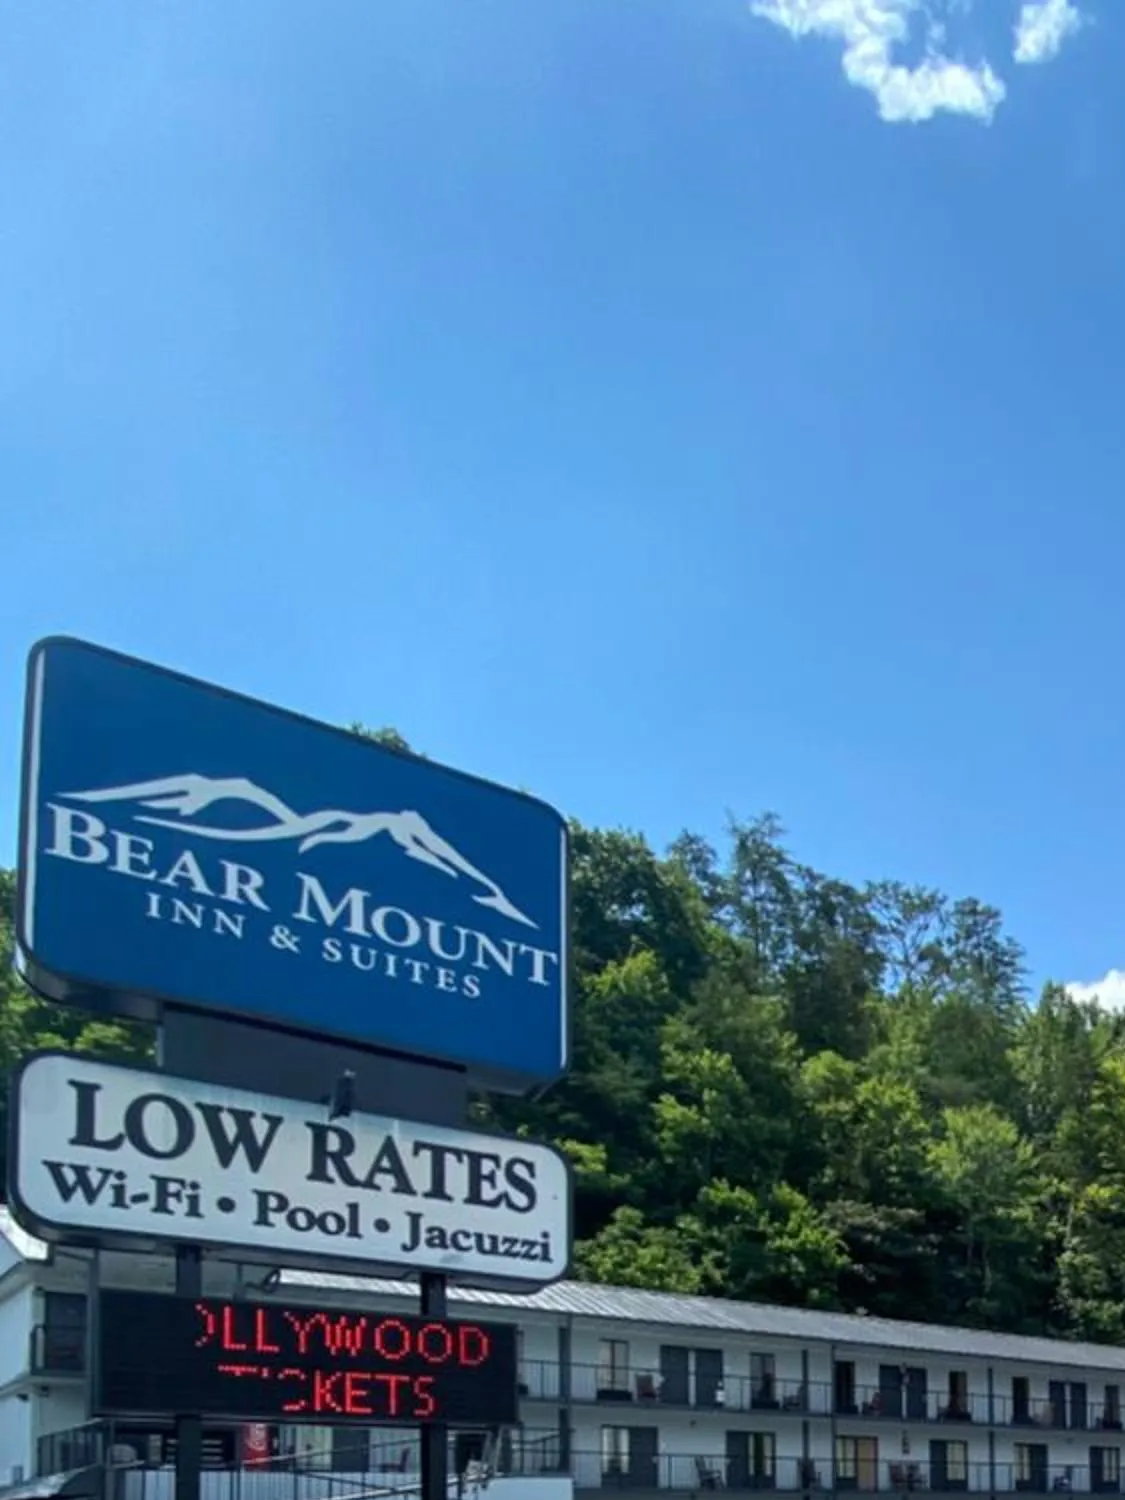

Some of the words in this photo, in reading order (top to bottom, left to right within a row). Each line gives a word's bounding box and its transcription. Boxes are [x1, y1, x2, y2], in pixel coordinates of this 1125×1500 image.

[45, 803, 270, 912] BEAR
[293, 872, 557, 986] MOUNT
[145, 894, 246, 939] INN
[271, 925, 300, 953] &
[322, 939, 481, 998] SUITES
[68, 1080, 284, 1173] LOW
[306, 1122, 537, 1213] RATES
[42, 1160, 203, 1218] Wi-Fi
[252, 1189, 363, 1239] Pool
[401, 1212, 553, 1263] Jacuzzi
